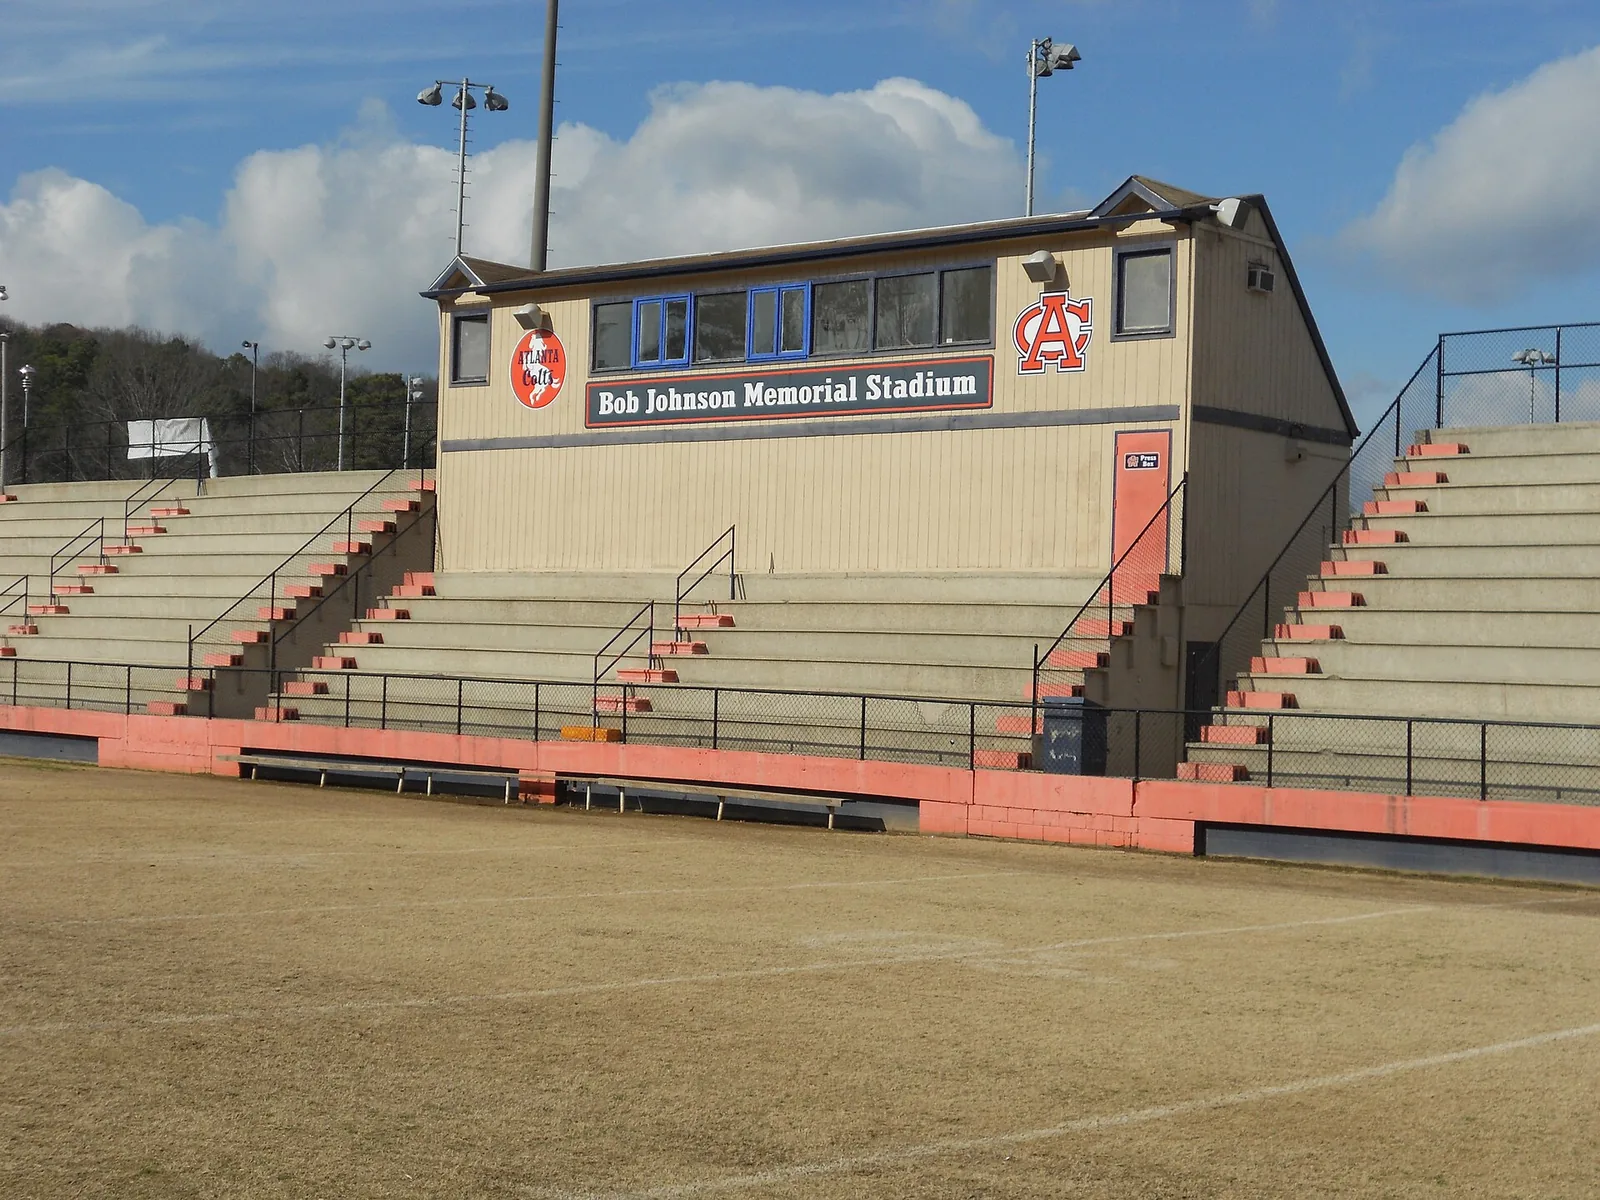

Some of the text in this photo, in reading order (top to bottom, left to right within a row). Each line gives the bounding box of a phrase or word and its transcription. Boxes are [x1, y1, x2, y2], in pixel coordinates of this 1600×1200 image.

[518, 349, 559, 365] ATLANTA
[522, 368, 554, 387] Colts
[598, 371, 977, 415] Bob Johnson Memorial Stadium
